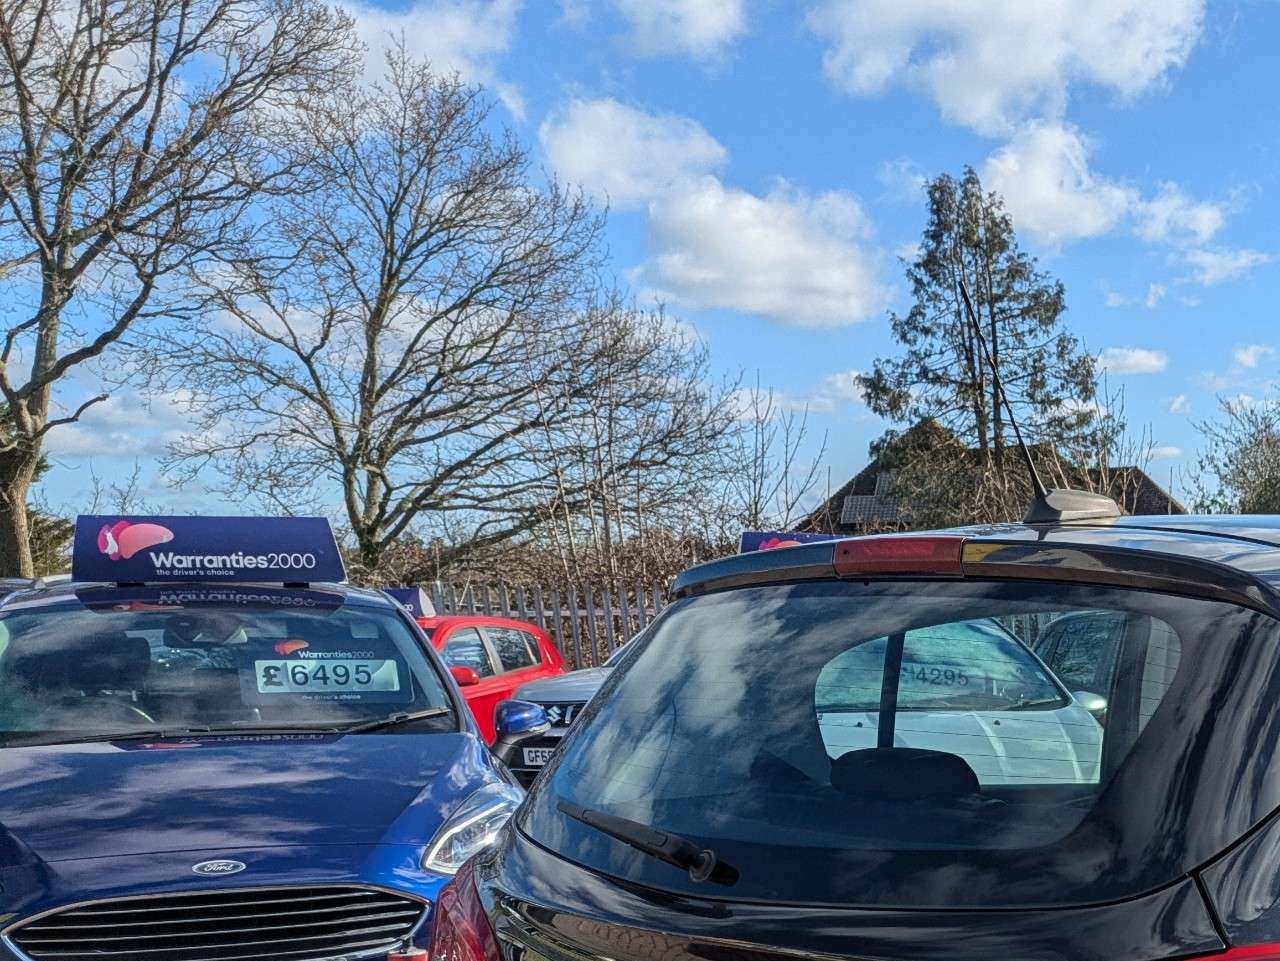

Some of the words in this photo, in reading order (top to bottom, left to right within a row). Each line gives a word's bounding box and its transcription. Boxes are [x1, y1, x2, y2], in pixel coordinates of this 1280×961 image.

[149, 551, 317, 569] Warranties2000
[297, 650, 375, 659] Warranties2000
[262, 664, 372, 687] £6495
[203, 862, 234, 873] Ford
